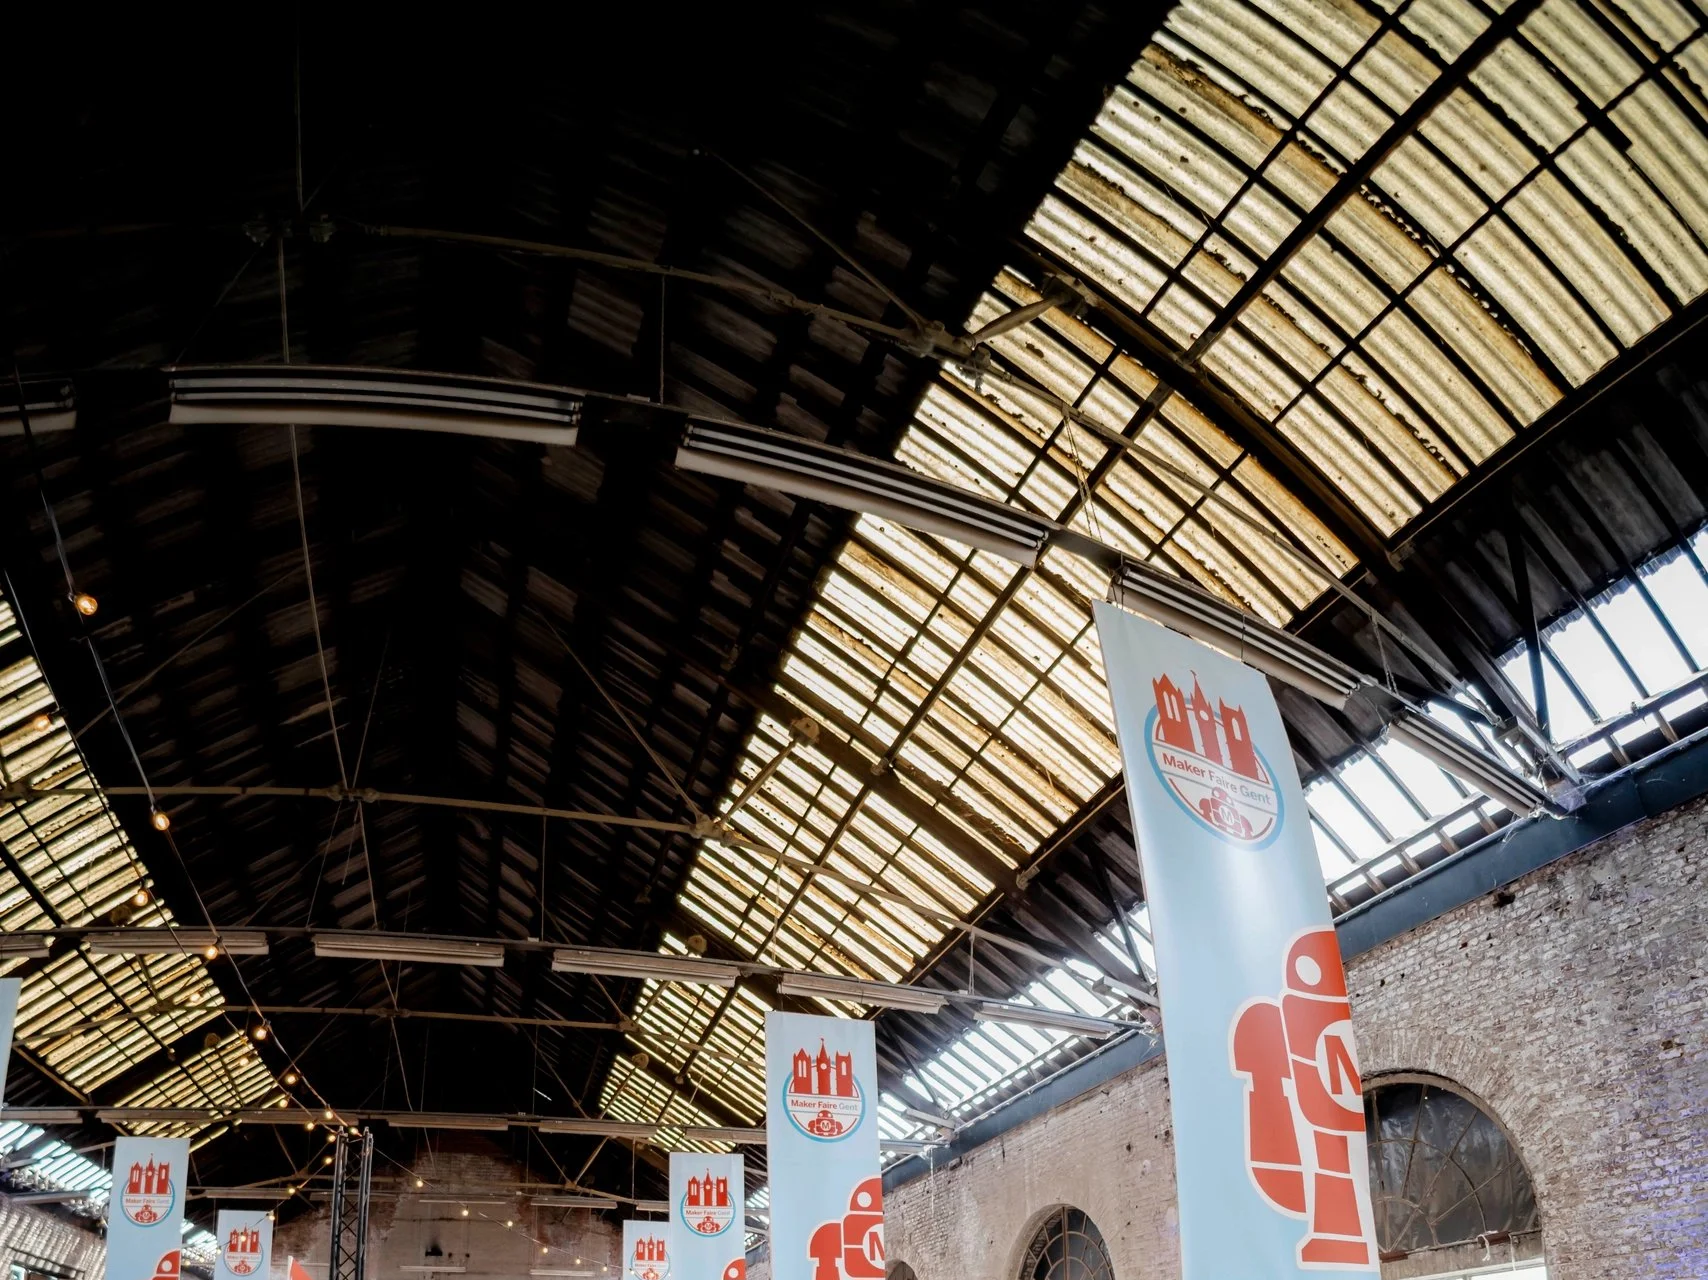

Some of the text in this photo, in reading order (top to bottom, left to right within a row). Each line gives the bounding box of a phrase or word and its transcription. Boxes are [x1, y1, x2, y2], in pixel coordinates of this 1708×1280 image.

[1162, 752, 1272, 806] Maker Faire Gent
[1220, 807, 1233, 824] M
[790, 1099, 858, 1112] Maker Faire Gent
[821, 1121, 830, 1130] M
